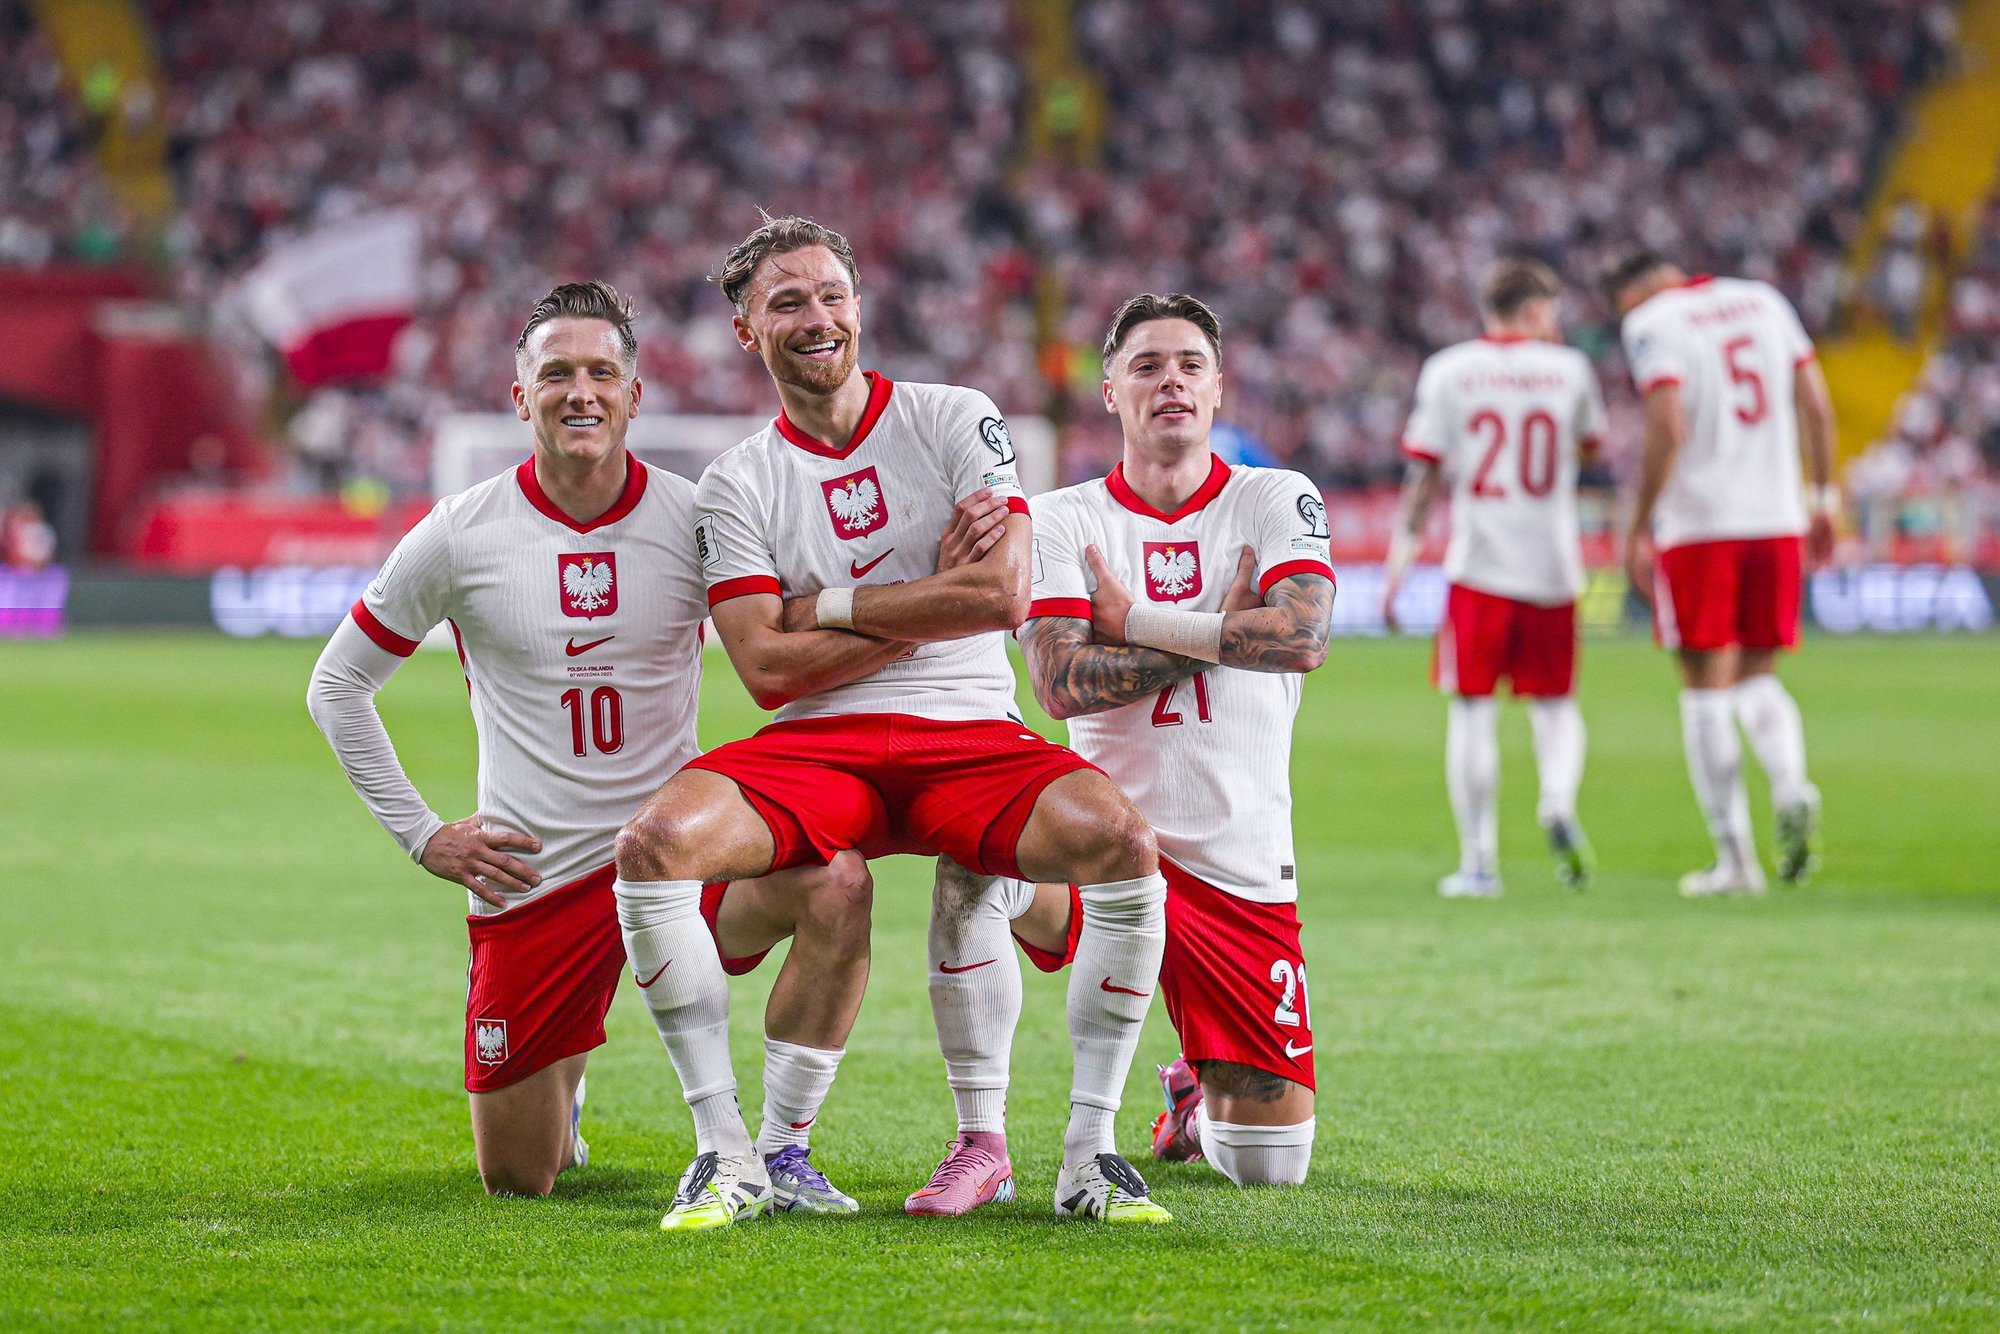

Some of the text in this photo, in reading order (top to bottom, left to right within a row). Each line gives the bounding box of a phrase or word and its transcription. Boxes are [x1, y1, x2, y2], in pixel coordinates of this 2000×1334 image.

[1723, 335, 1769, 426] 5
[1467, 408, 1557, 499] 20
[560, 686, 625, 757] 10
[1151, 670, 1212, 728] 21
[1270, 959, 1312, 1031] 21
